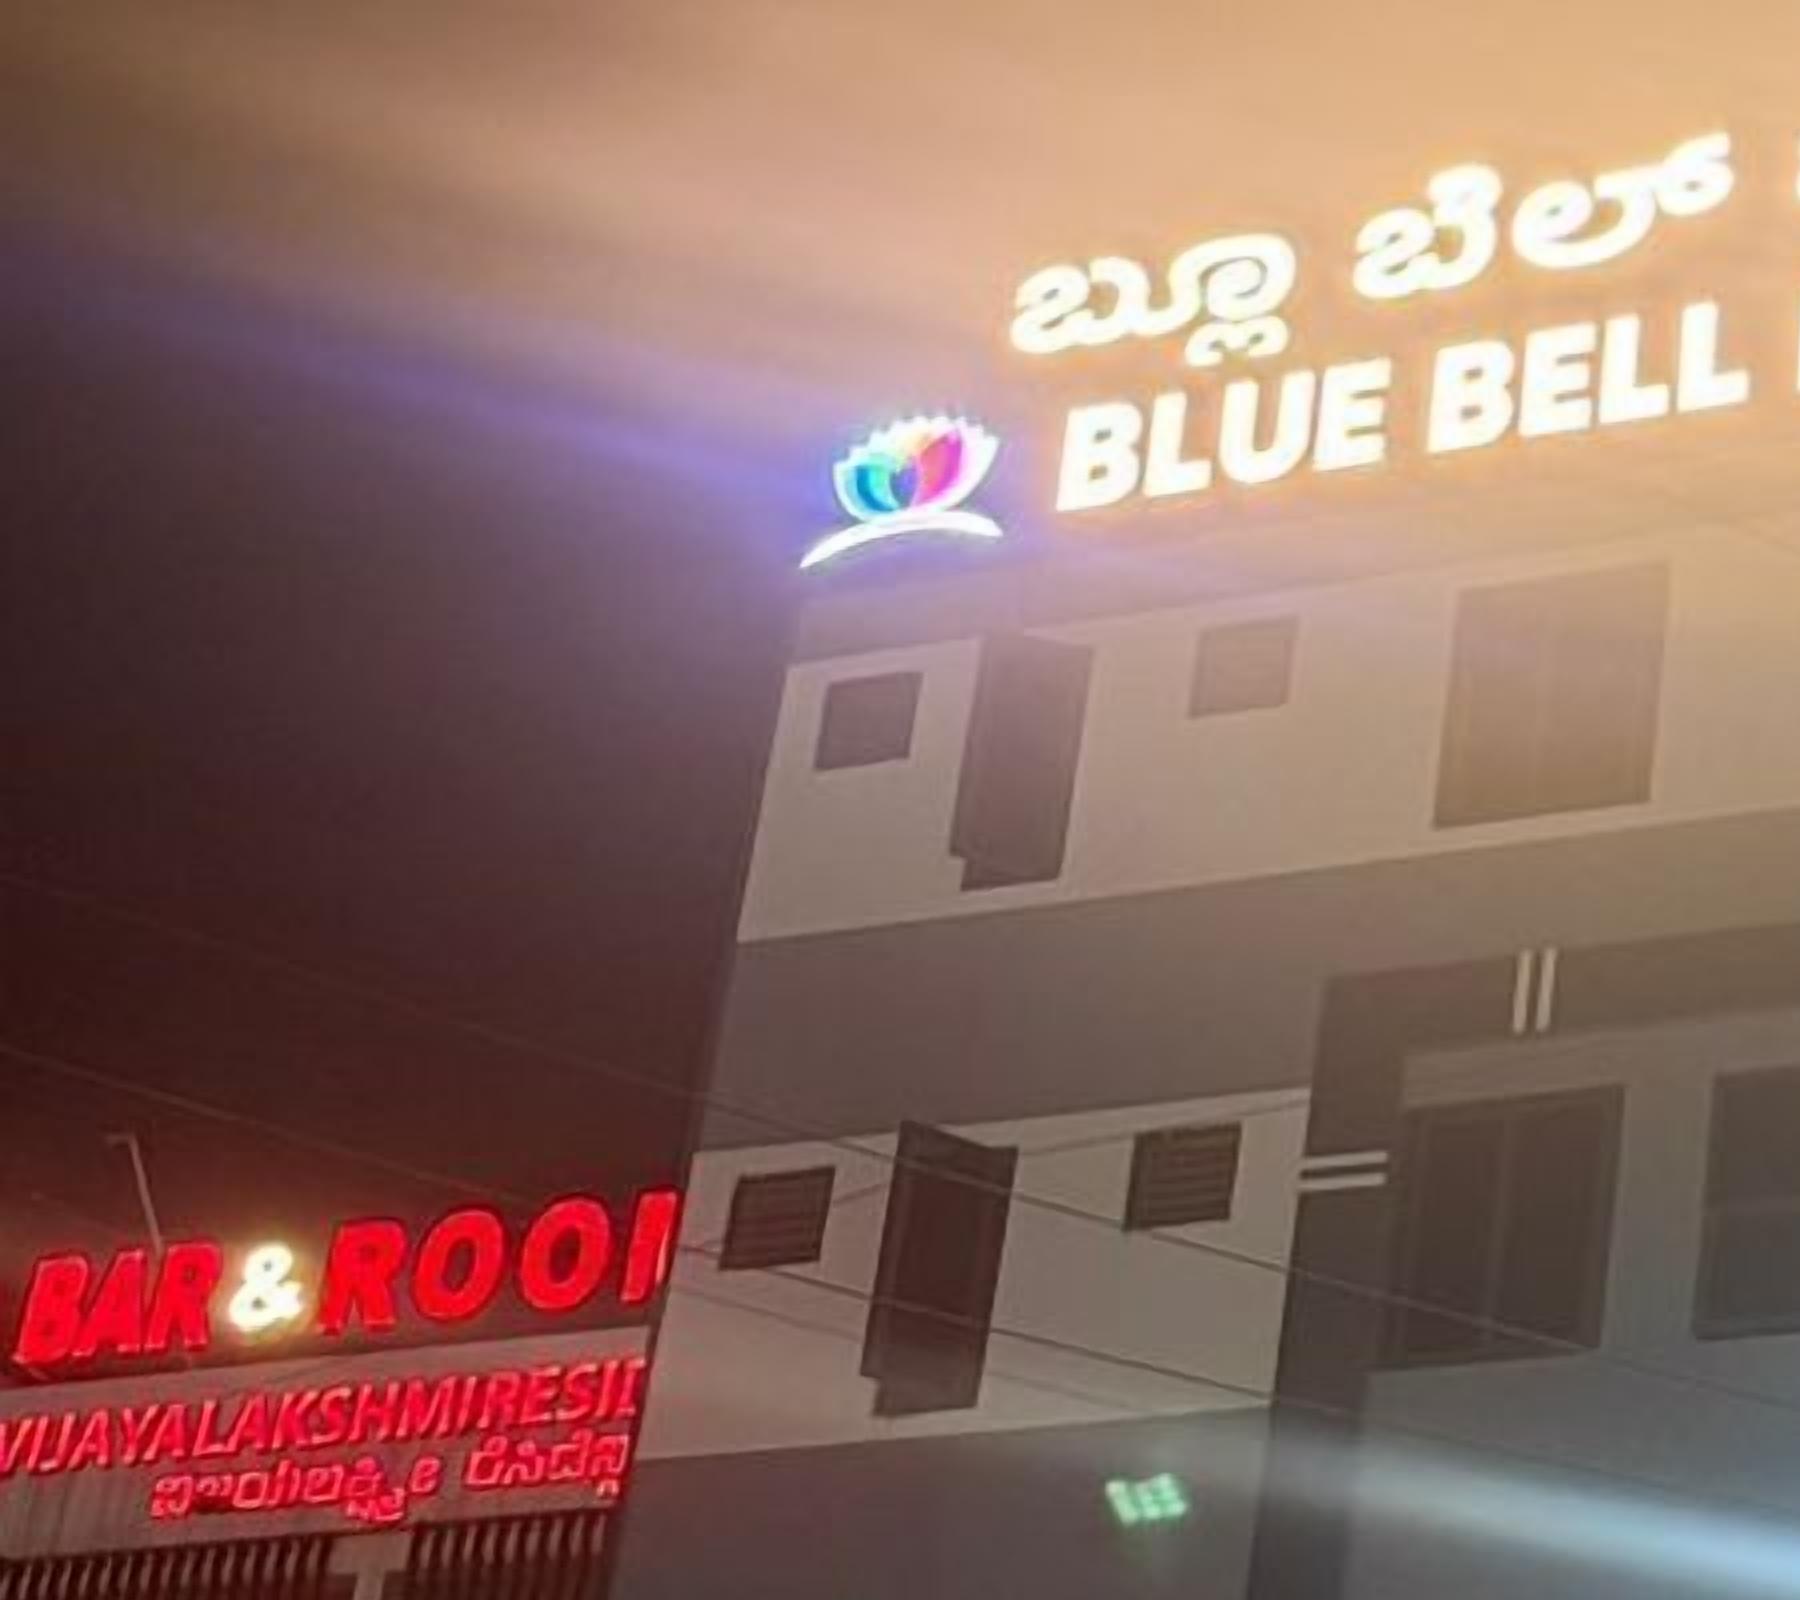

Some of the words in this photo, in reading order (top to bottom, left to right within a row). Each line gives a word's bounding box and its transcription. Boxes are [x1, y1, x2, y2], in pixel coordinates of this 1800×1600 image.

[1353, 130, 1733, 300] ಬೆಲ್
[1056, 358, 1390, 512] BLUE
[1428, 302, 1750, 454] BELL
[12, 1240, 222, 1364] BAR
[227, 1243, 305, 1332] &
